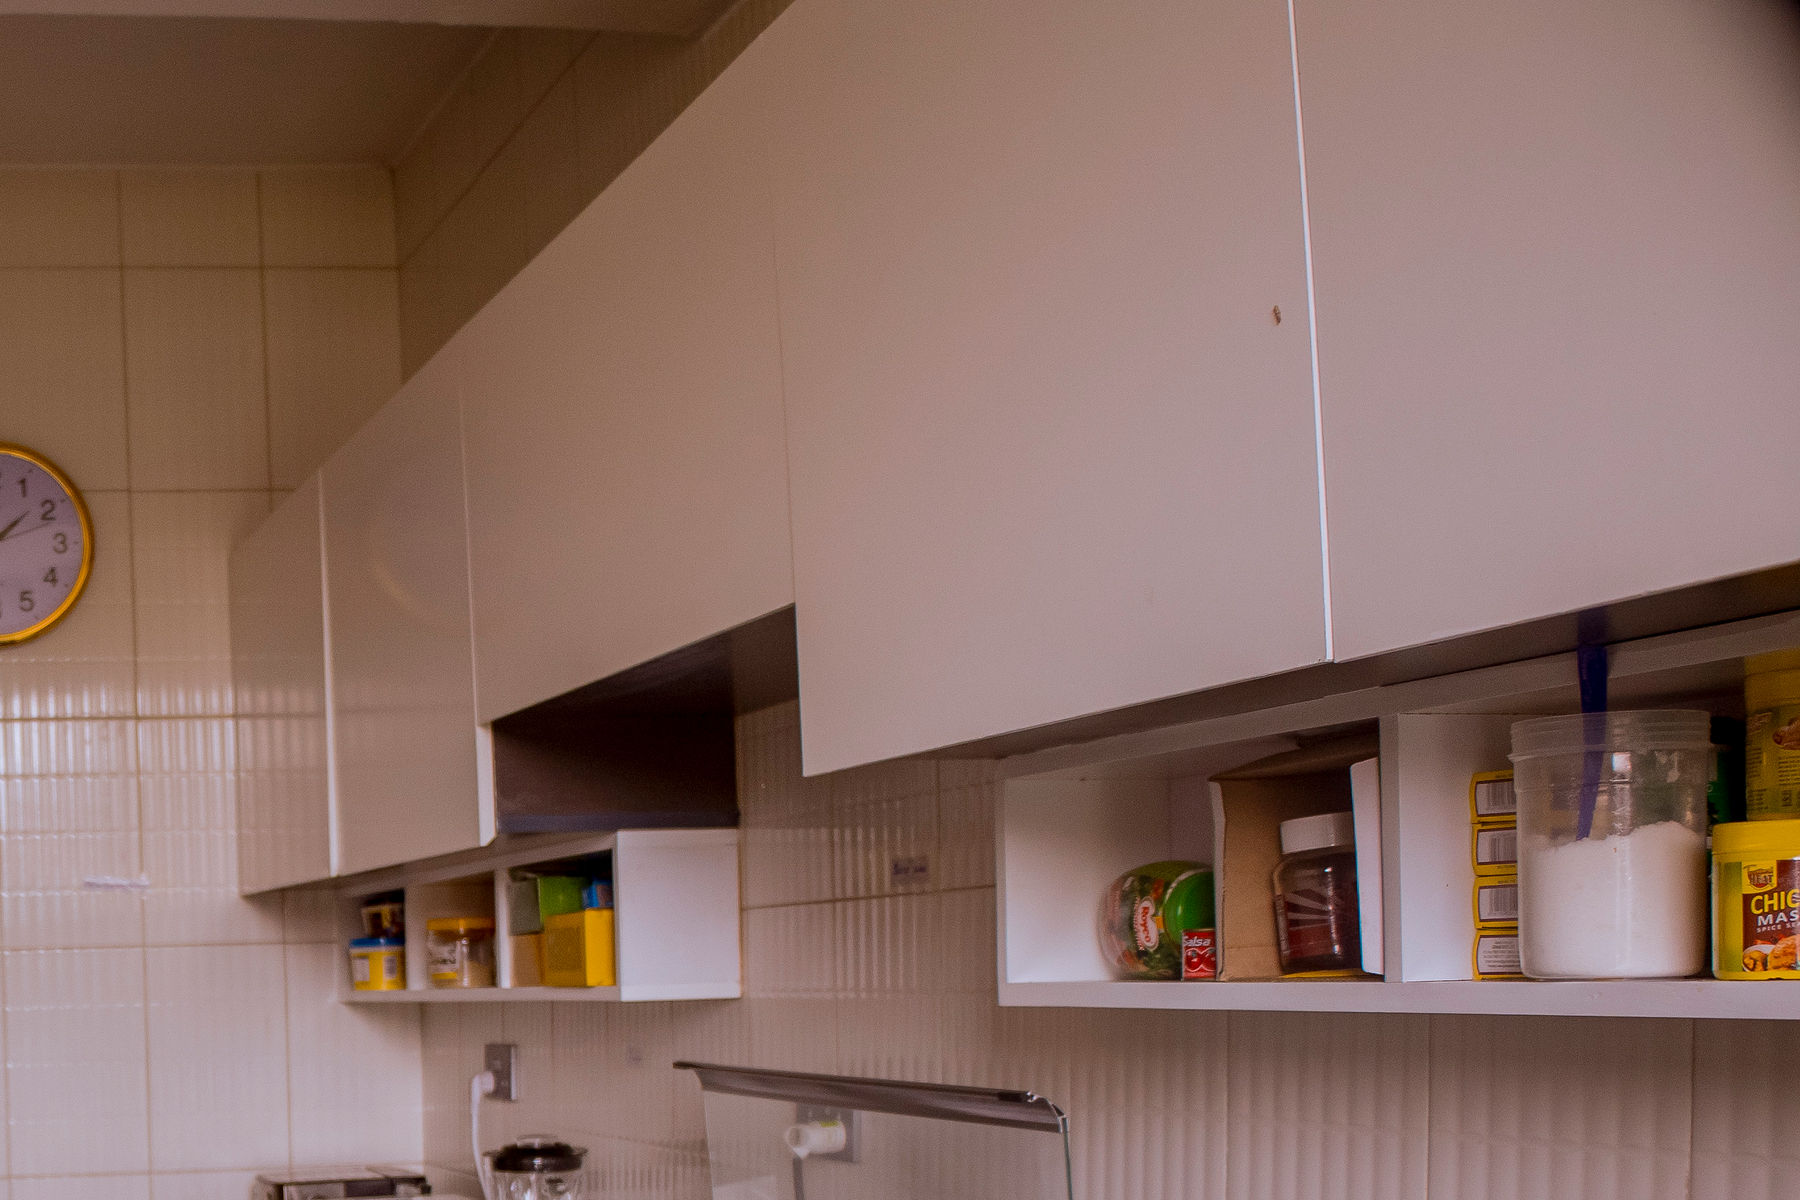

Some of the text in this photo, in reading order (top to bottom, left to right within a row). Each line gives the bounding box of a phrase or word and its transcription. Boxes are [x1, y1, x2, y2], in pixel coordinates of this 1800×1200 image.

[18, 477, 27, 498] 1
[40, 500, 56, 521] 2
[53, 533, 67, 554] 3
[43, 567, 57, 587] 4
[19, 591, 34, 611] 5
[1140, 906, 1151, 943] Royco
[1757, 910, 1800, 926] MAS
[1184, 936, 1211, 947] Salsa
